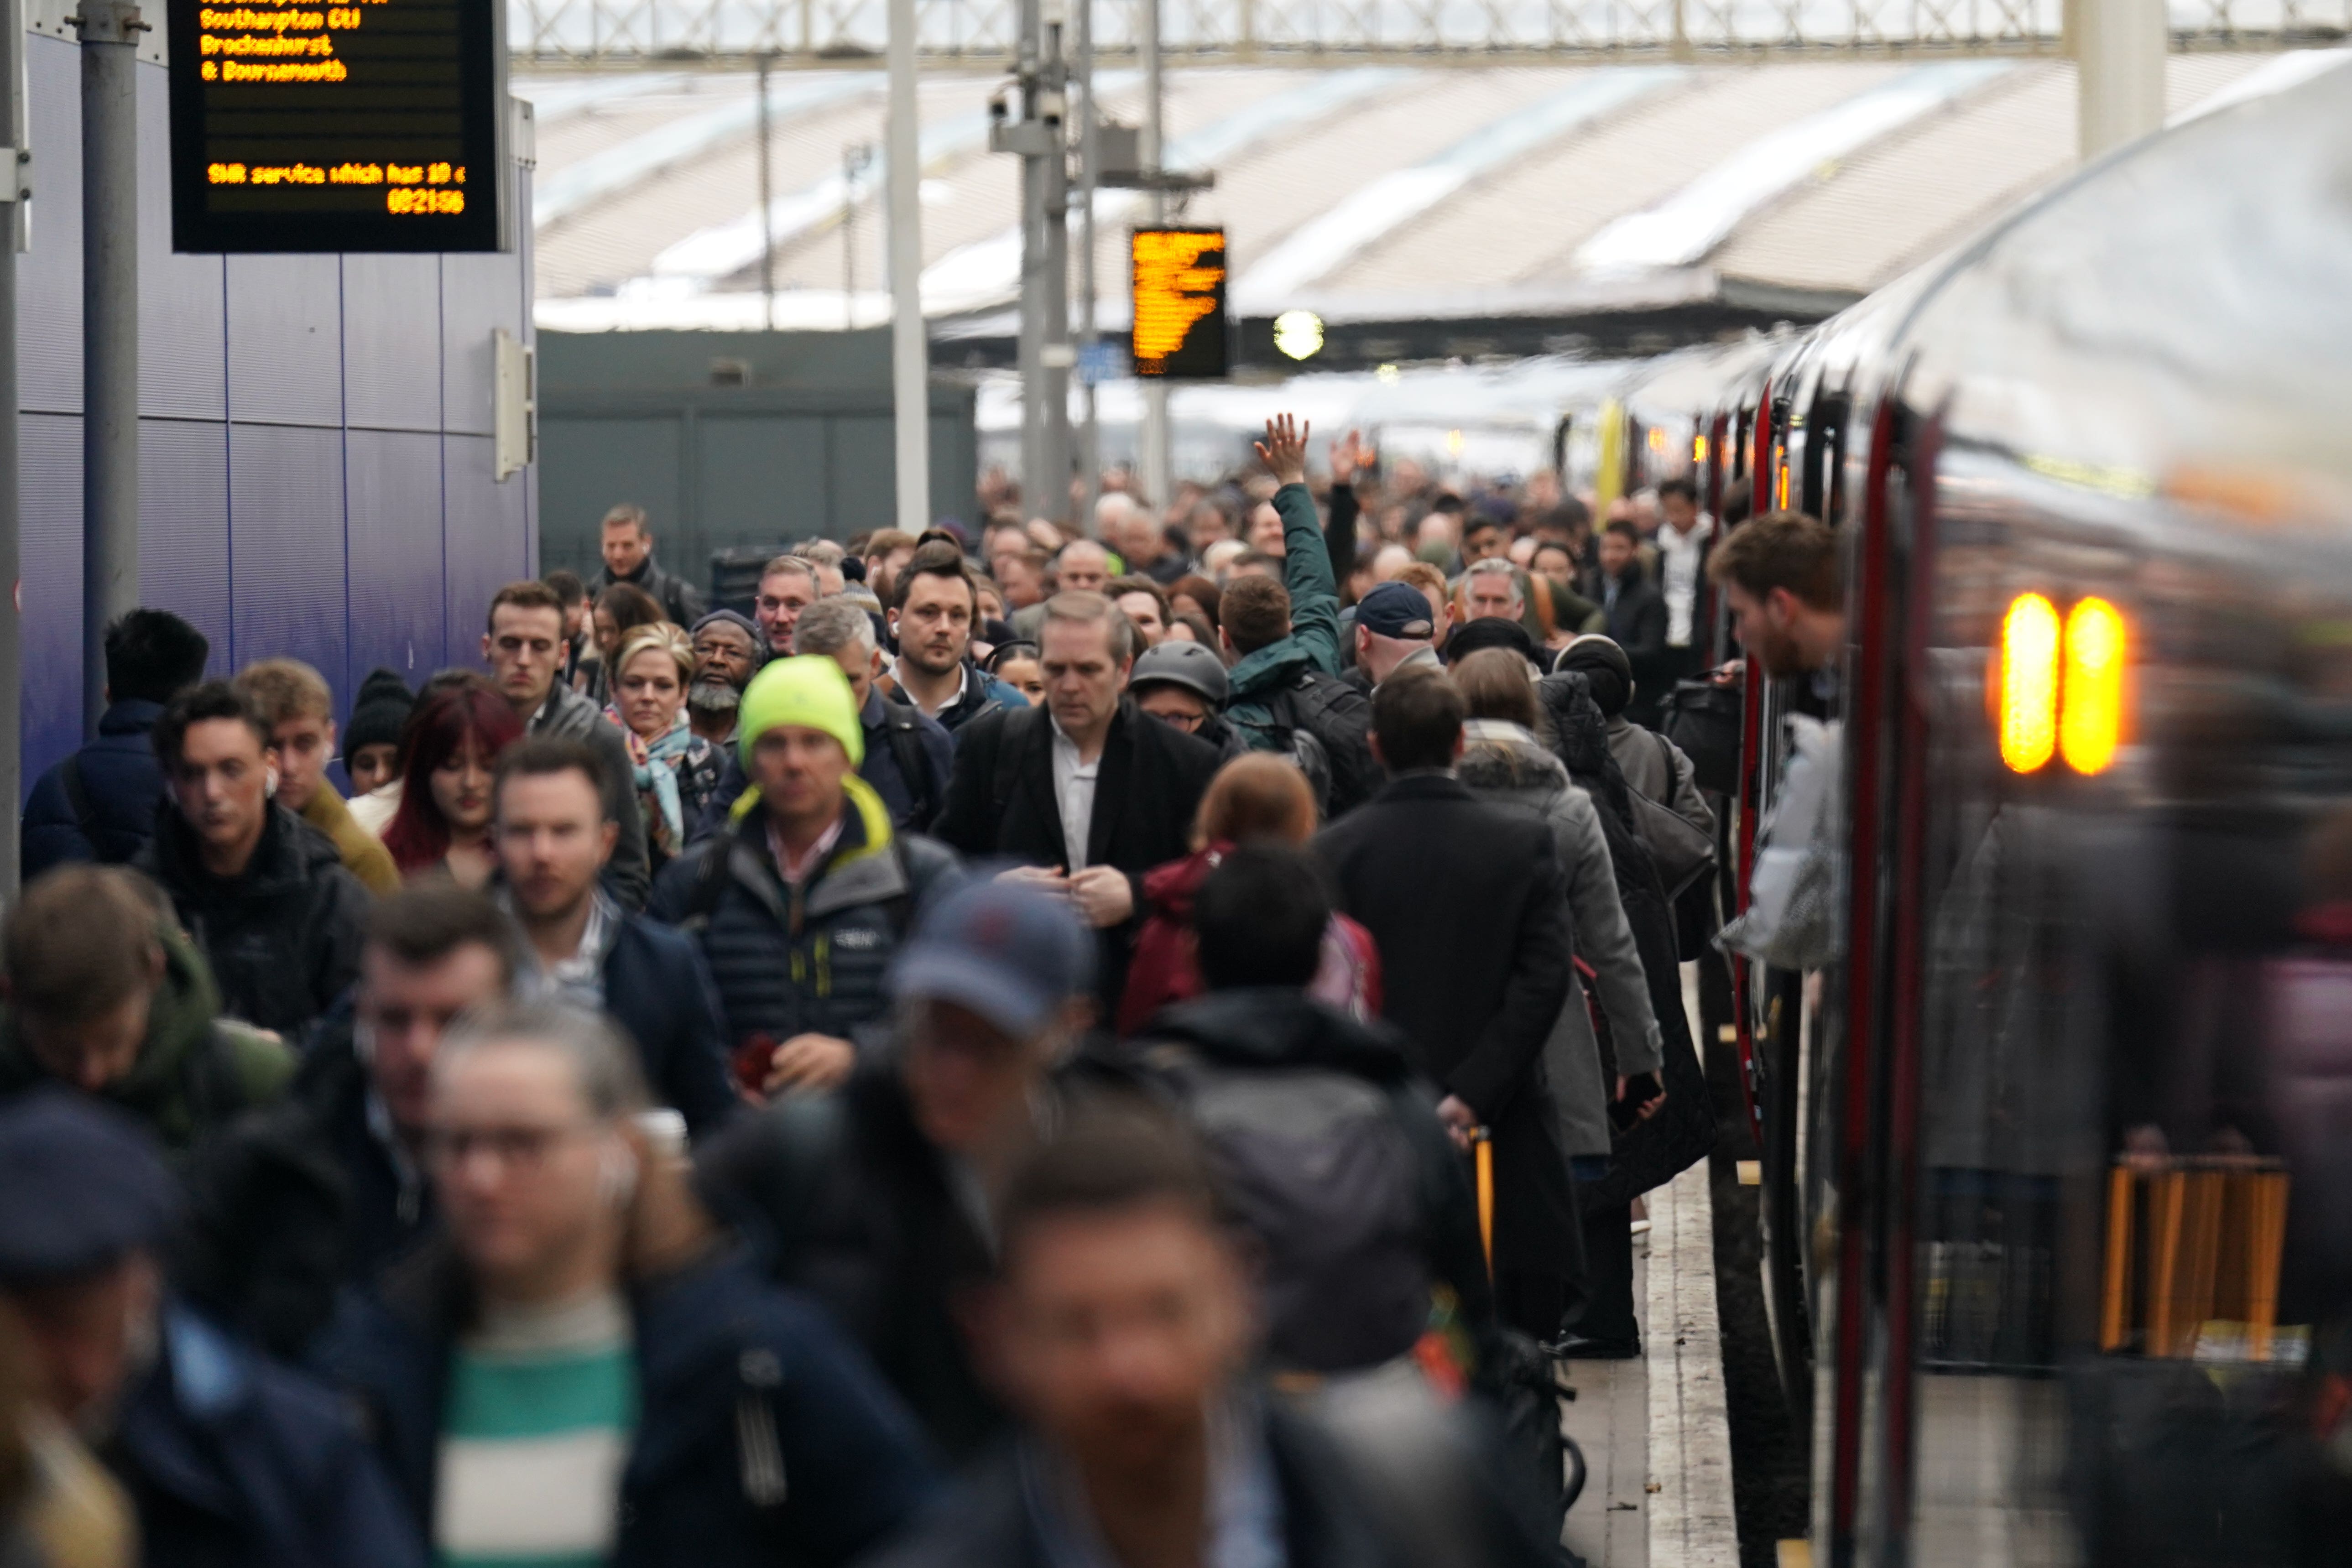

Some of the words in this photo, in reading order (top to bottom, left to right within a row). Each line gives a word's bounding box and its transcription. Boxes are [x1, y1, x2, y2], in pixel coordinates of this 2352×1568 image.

[200, 8, 324, 34] Southampton
[200, 34, 333, 56] Brockenhurst
[201, 61, 218, 81] &
[222, 59, 347, 82] Bournemouth
[250, 163, 325, 184] service
[329, 162, 384, 184] which
[386, 163, 424, 185] has
